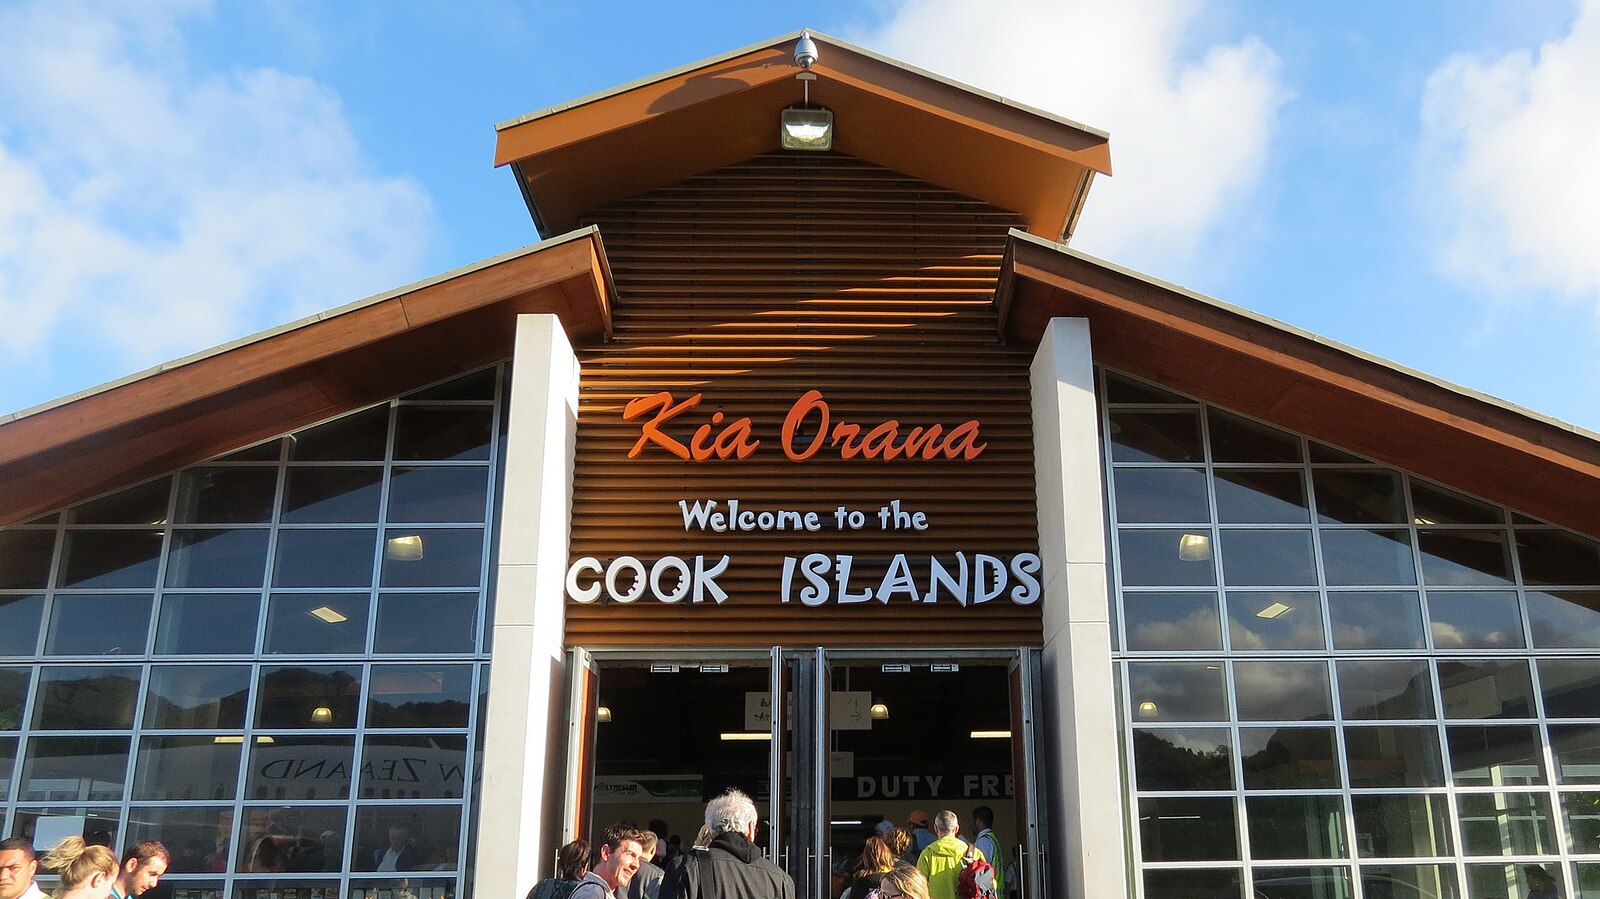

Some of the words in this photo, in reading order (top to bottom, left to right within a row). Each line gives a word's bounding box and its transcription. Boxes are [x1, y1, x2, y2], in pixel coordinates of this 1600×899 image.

[623, 390, 760, 463] Kia
[781, 390, 988, 463] Orana
[678, 499, 821, 532] Welcome
[835, 506, 865, 531] to
[877, 499, 929, 532] the
[566, 554, 730, 605] COOK
[781, 551, 1043, 608] ISLANDS
[857, 775, 943, 798] DUTY
